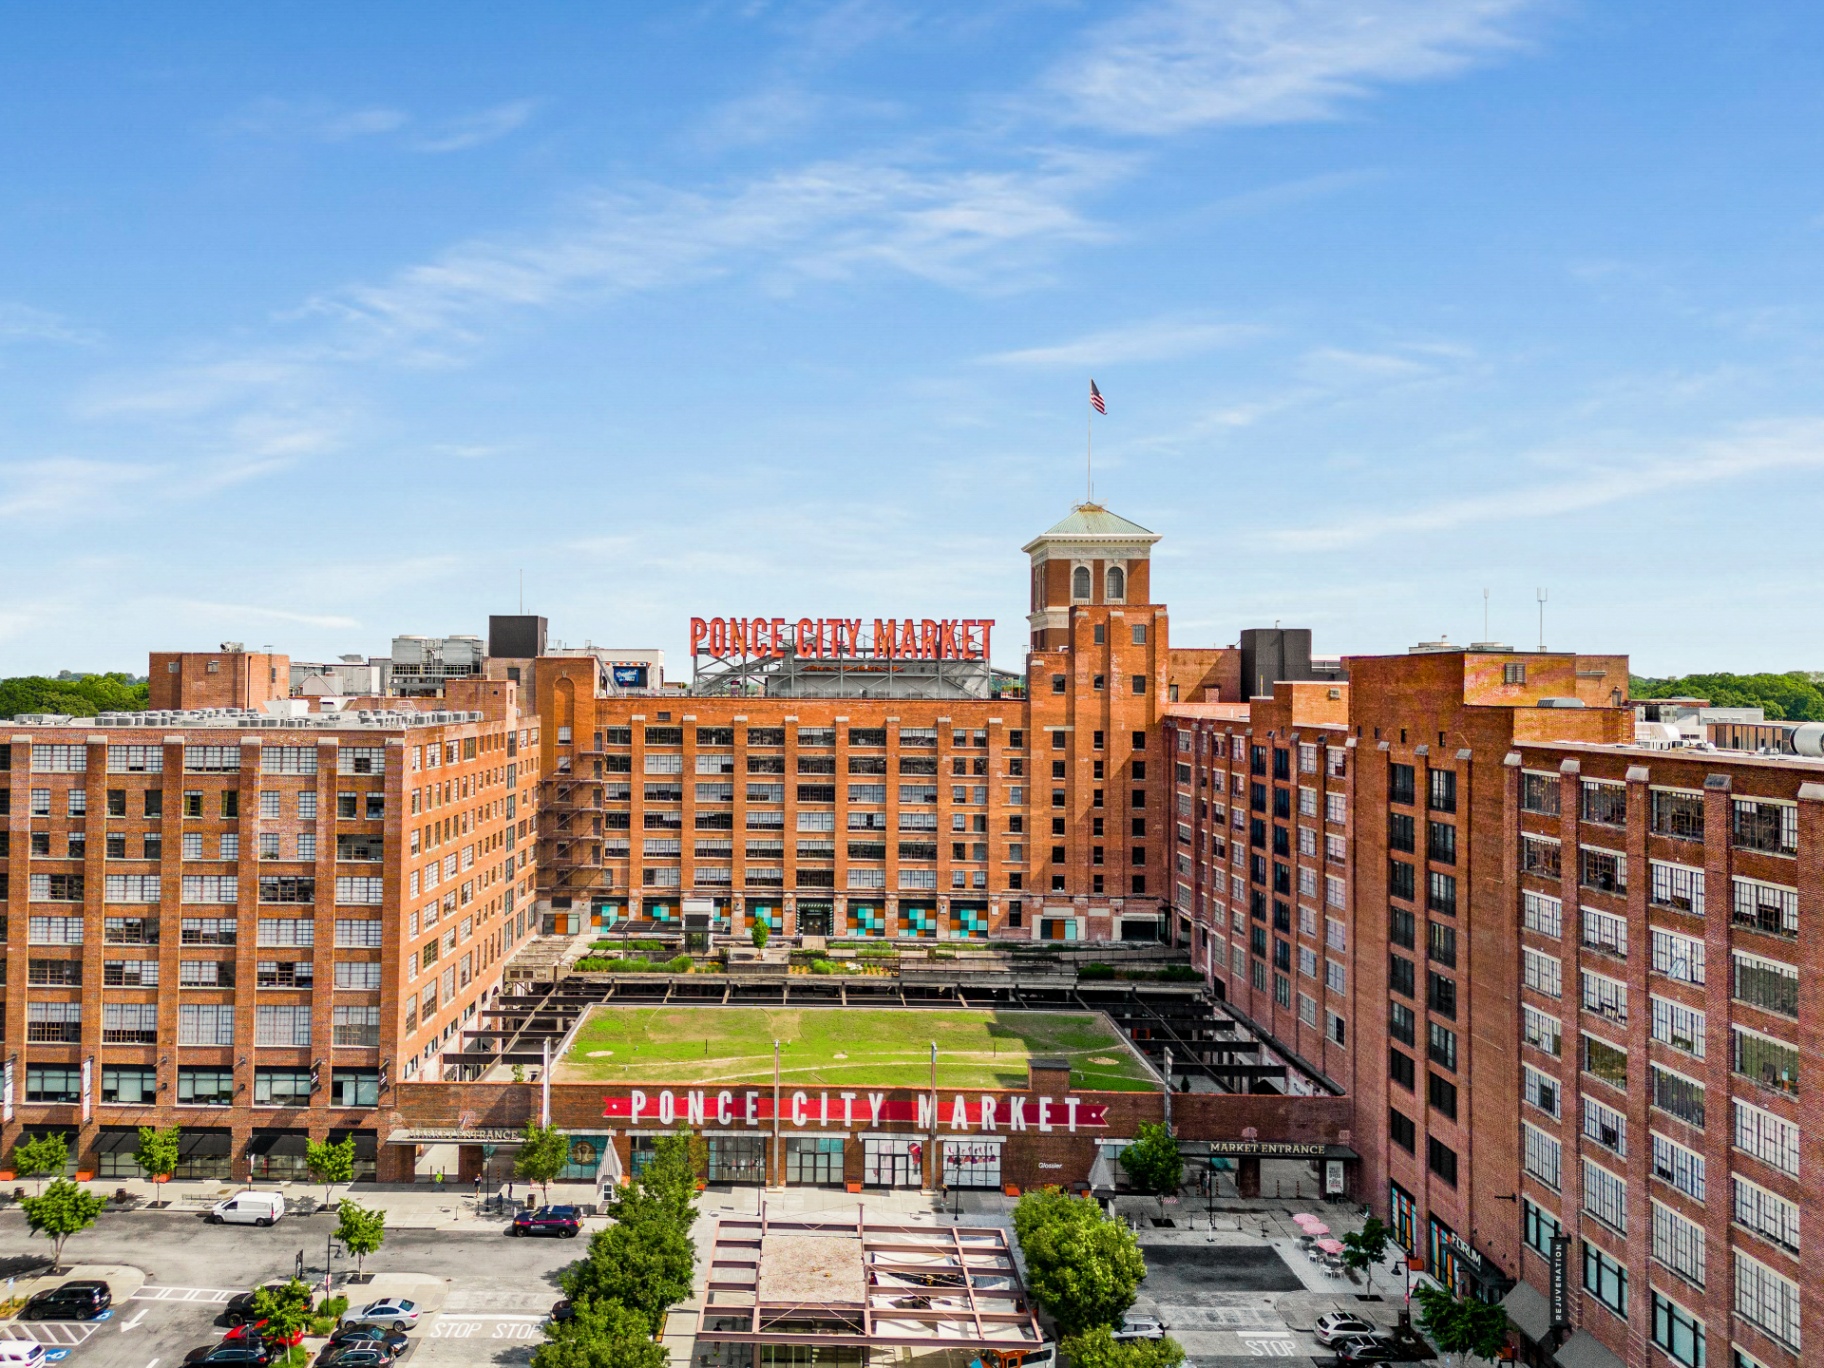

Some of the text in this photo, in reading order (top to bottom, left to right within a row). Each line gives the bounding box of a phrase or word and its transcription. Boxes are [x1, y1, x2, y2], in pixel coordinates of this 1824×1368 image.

[690, 617, 995, 659] PONCE CITY MARKET
[631, 1090, 1080, 1132] PONCE CITY MARKET
[456, 1129, 519, 1140] ENTRANCE
[1210, 1143, 1325, 1155] MARKET ENTRANCE
[1451, 1231, 1482, 1267] FORUM
[430, 1322, 543, 1339] STOP STOP
[1245, 1340, 1296, 1356] STOP
